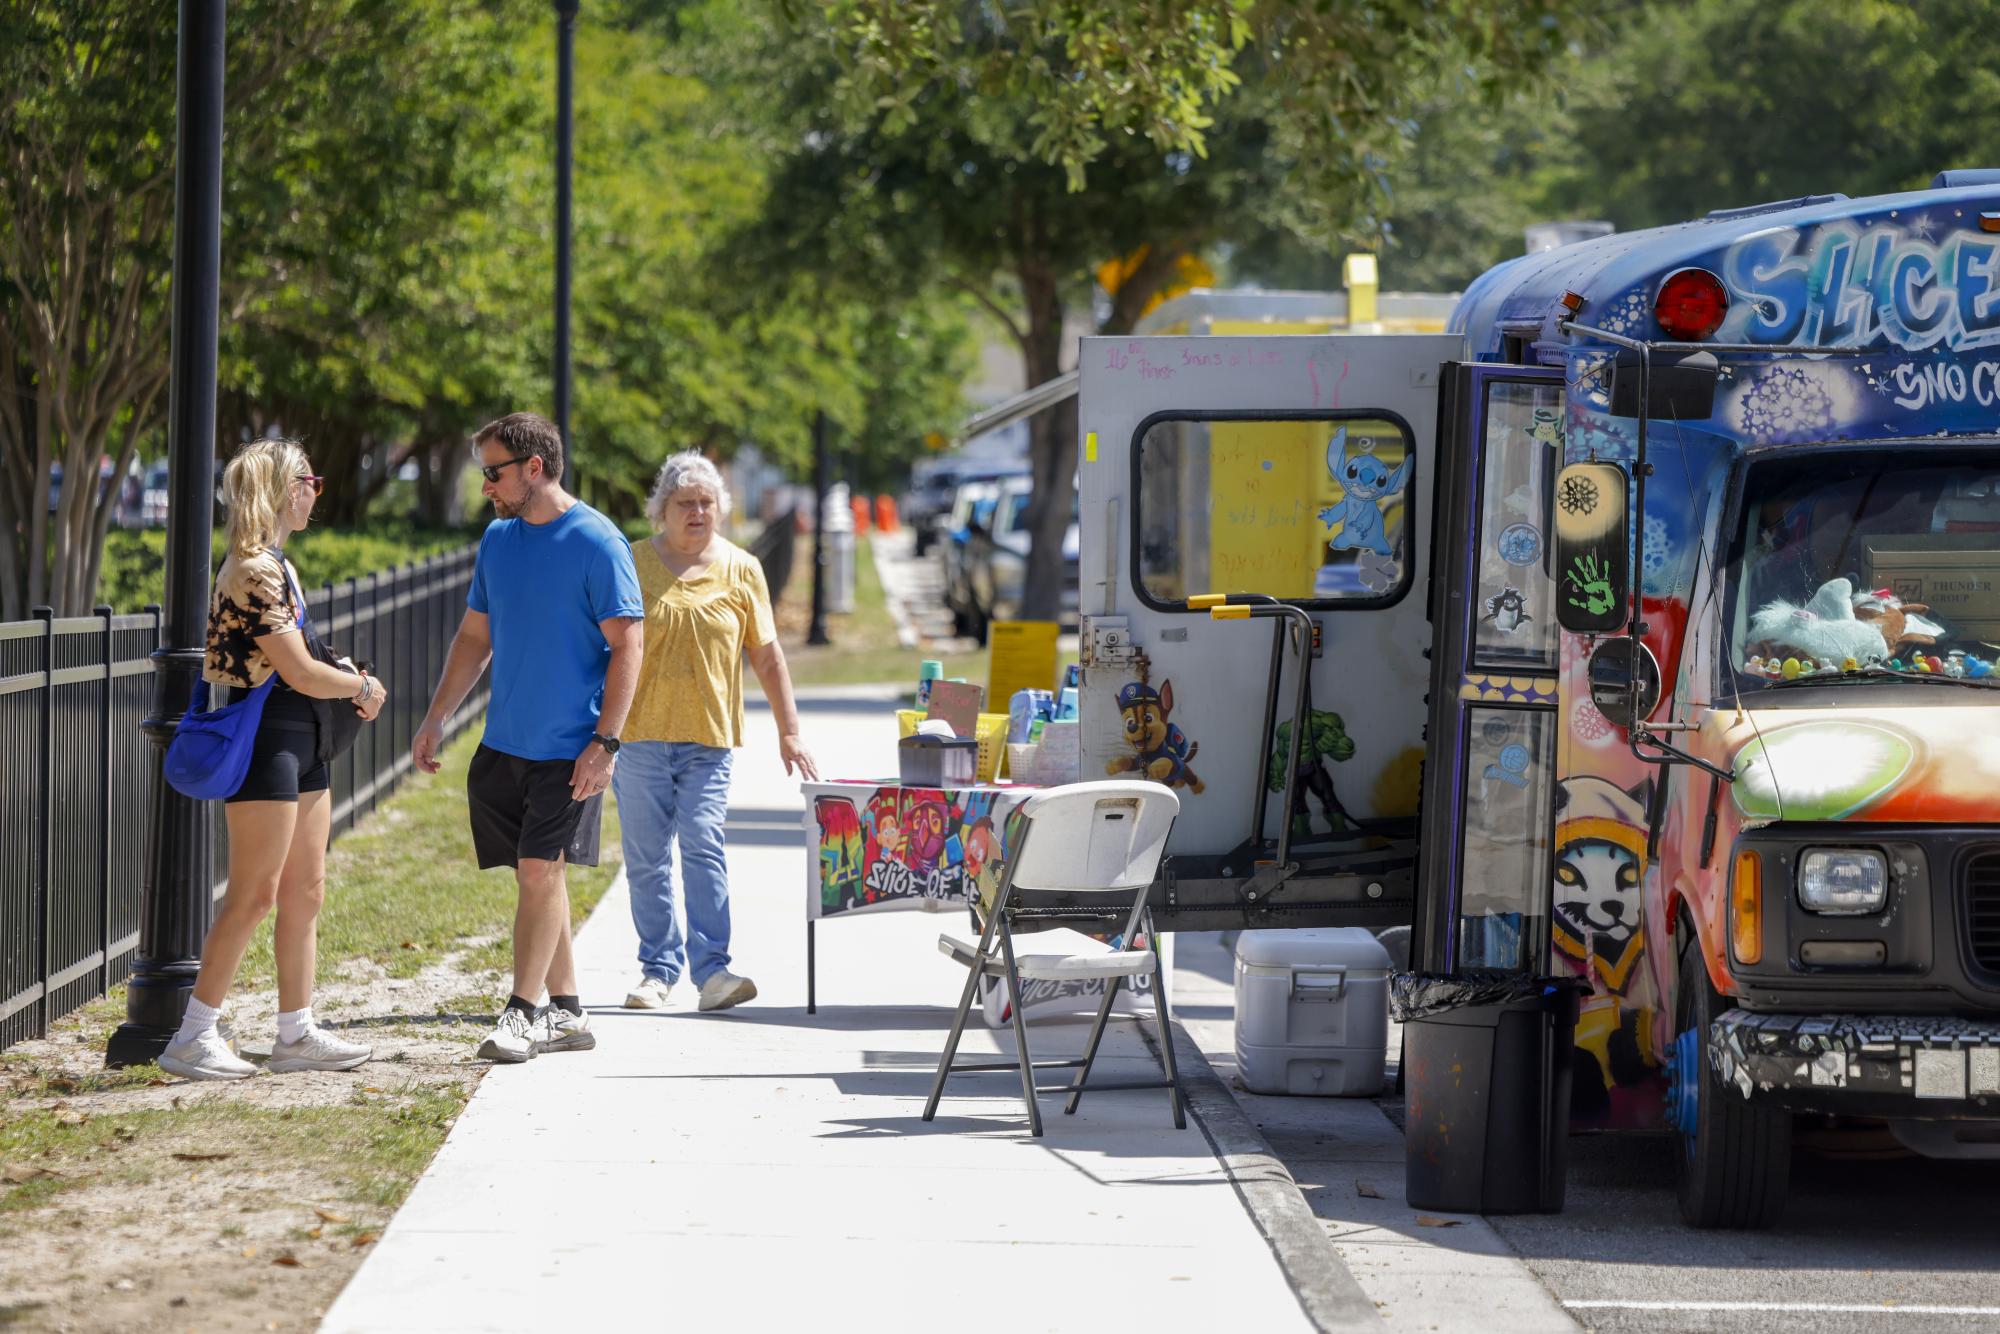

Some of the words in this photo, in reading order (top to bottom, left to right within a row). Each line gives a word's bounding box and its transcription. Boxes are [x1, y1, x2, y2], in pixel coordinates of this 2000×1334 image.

[1894, 362, 1967, 410] SNO
[1973, 361, 2000, 406] C
[1933, 582, 1991, 592] THUNDER
[1932, 593, 1970, 603] GROUP
[927, 868, 954, 896] OF
